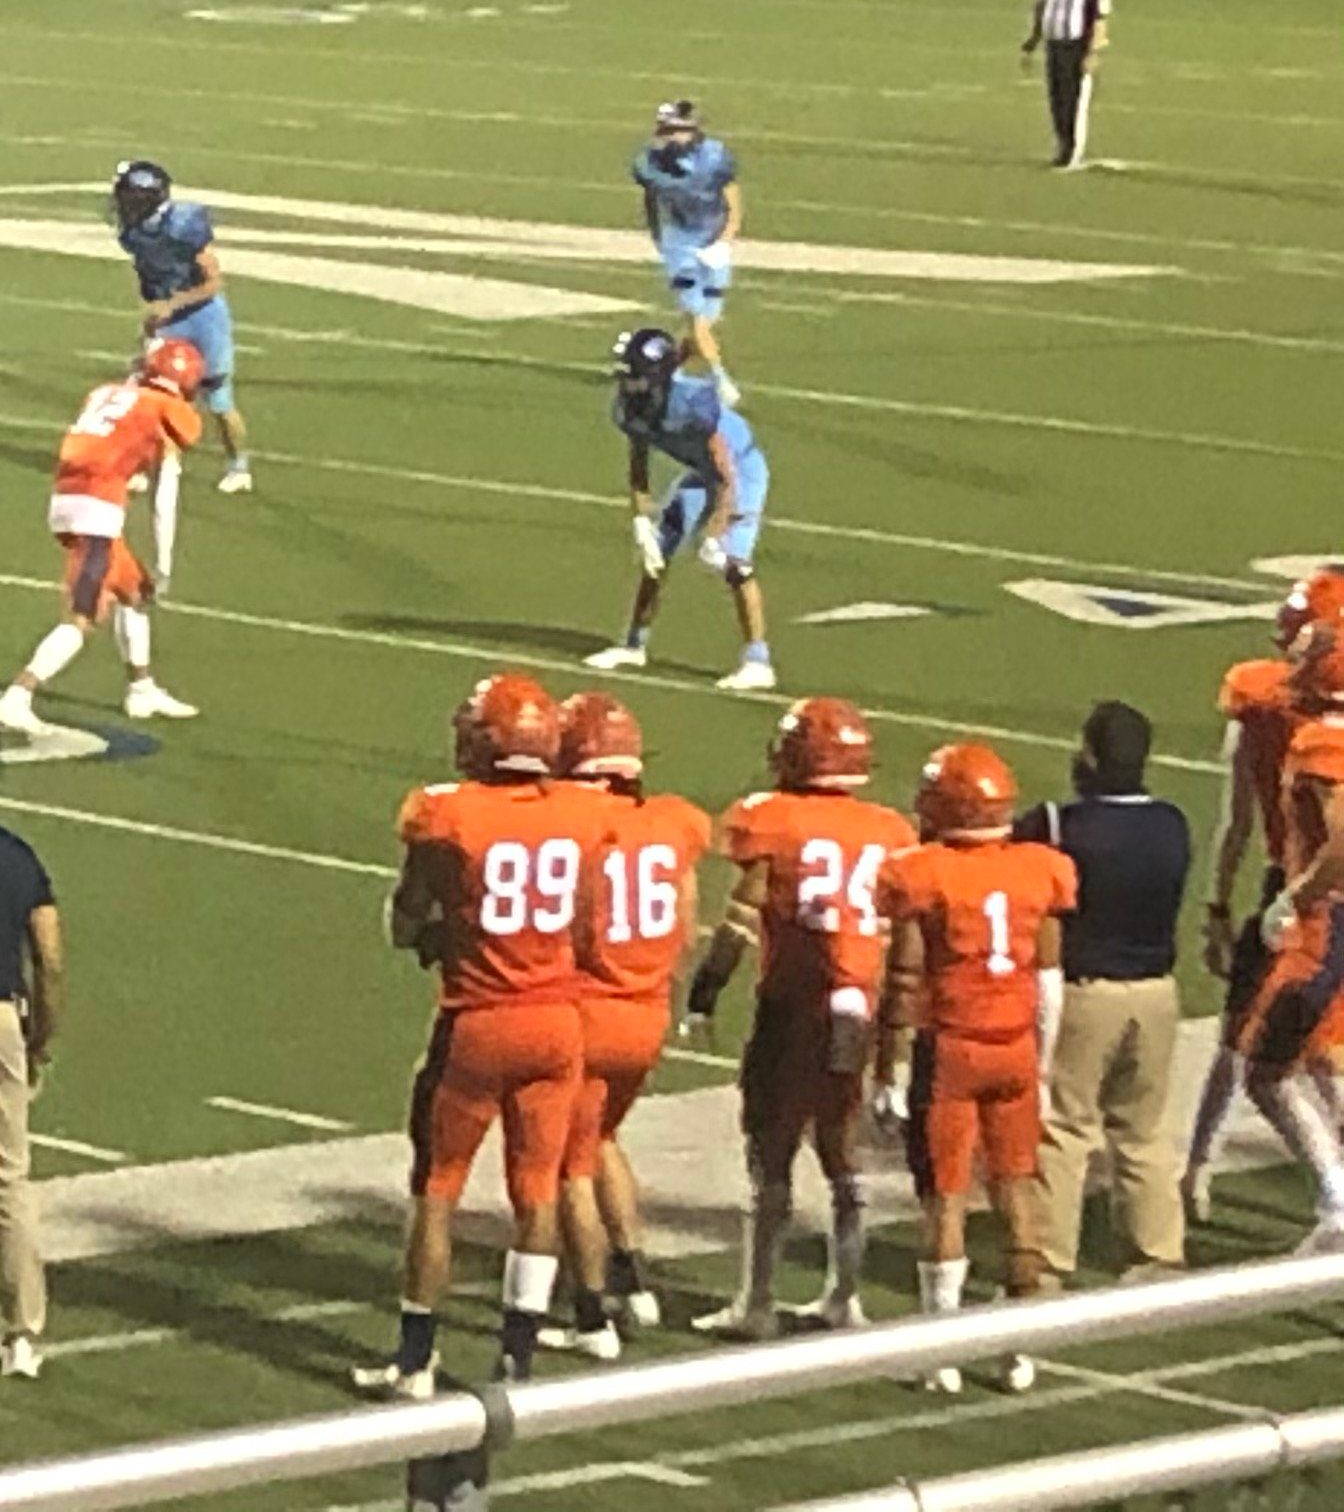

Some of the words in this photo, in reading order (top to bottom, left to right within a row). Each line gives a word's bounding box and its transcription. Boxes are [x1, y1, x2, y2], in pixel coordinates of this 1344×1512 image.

[480, 838, 580, 935] 89
[603, 843, 678, 943] 16
[798, 838, 891, 936] 24
[983, 890, 1017, 975] 1
